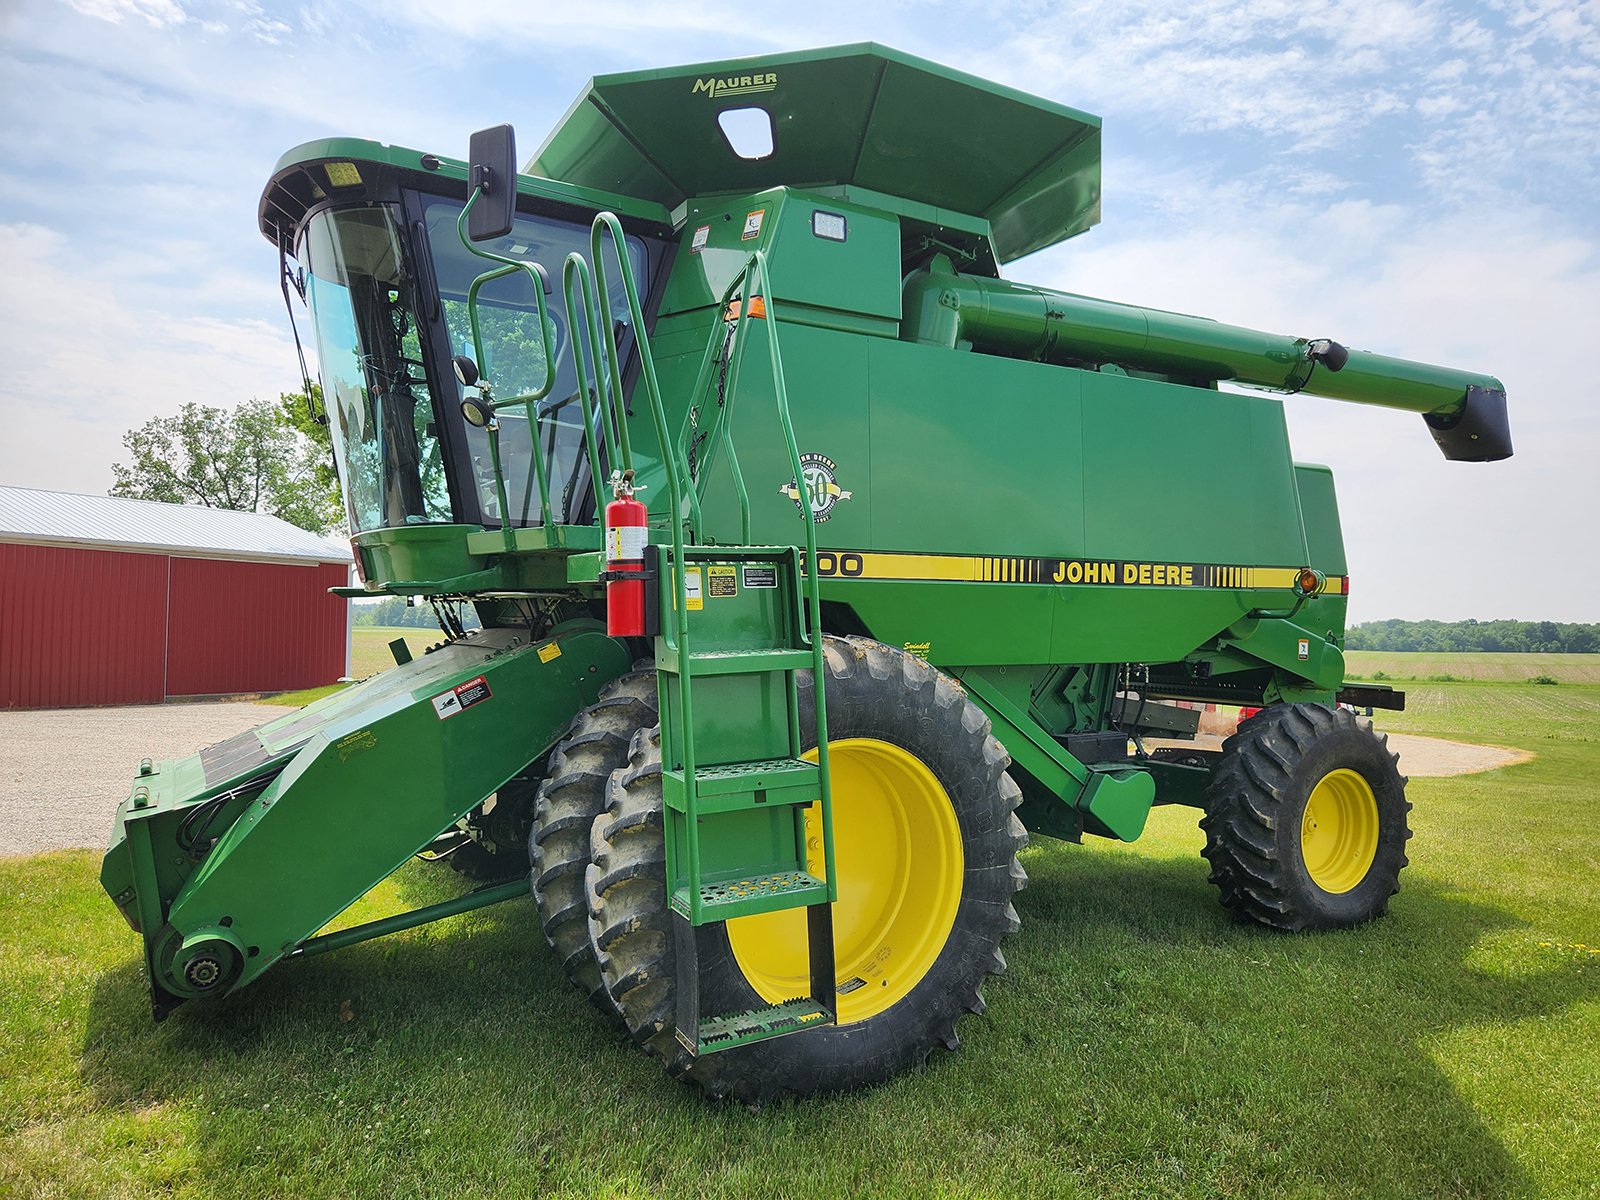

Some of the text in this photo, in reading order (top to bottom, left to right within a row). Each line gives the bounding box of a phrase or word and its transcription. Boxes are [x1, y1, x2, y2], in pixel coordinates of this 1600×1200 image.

[691, 72, 778, 98] MAURER
[804, 472, 827, 507] 50
[1052, 561, 1193, 586] JOHN DEERE
[461, 678, 482, 690] DANGER
